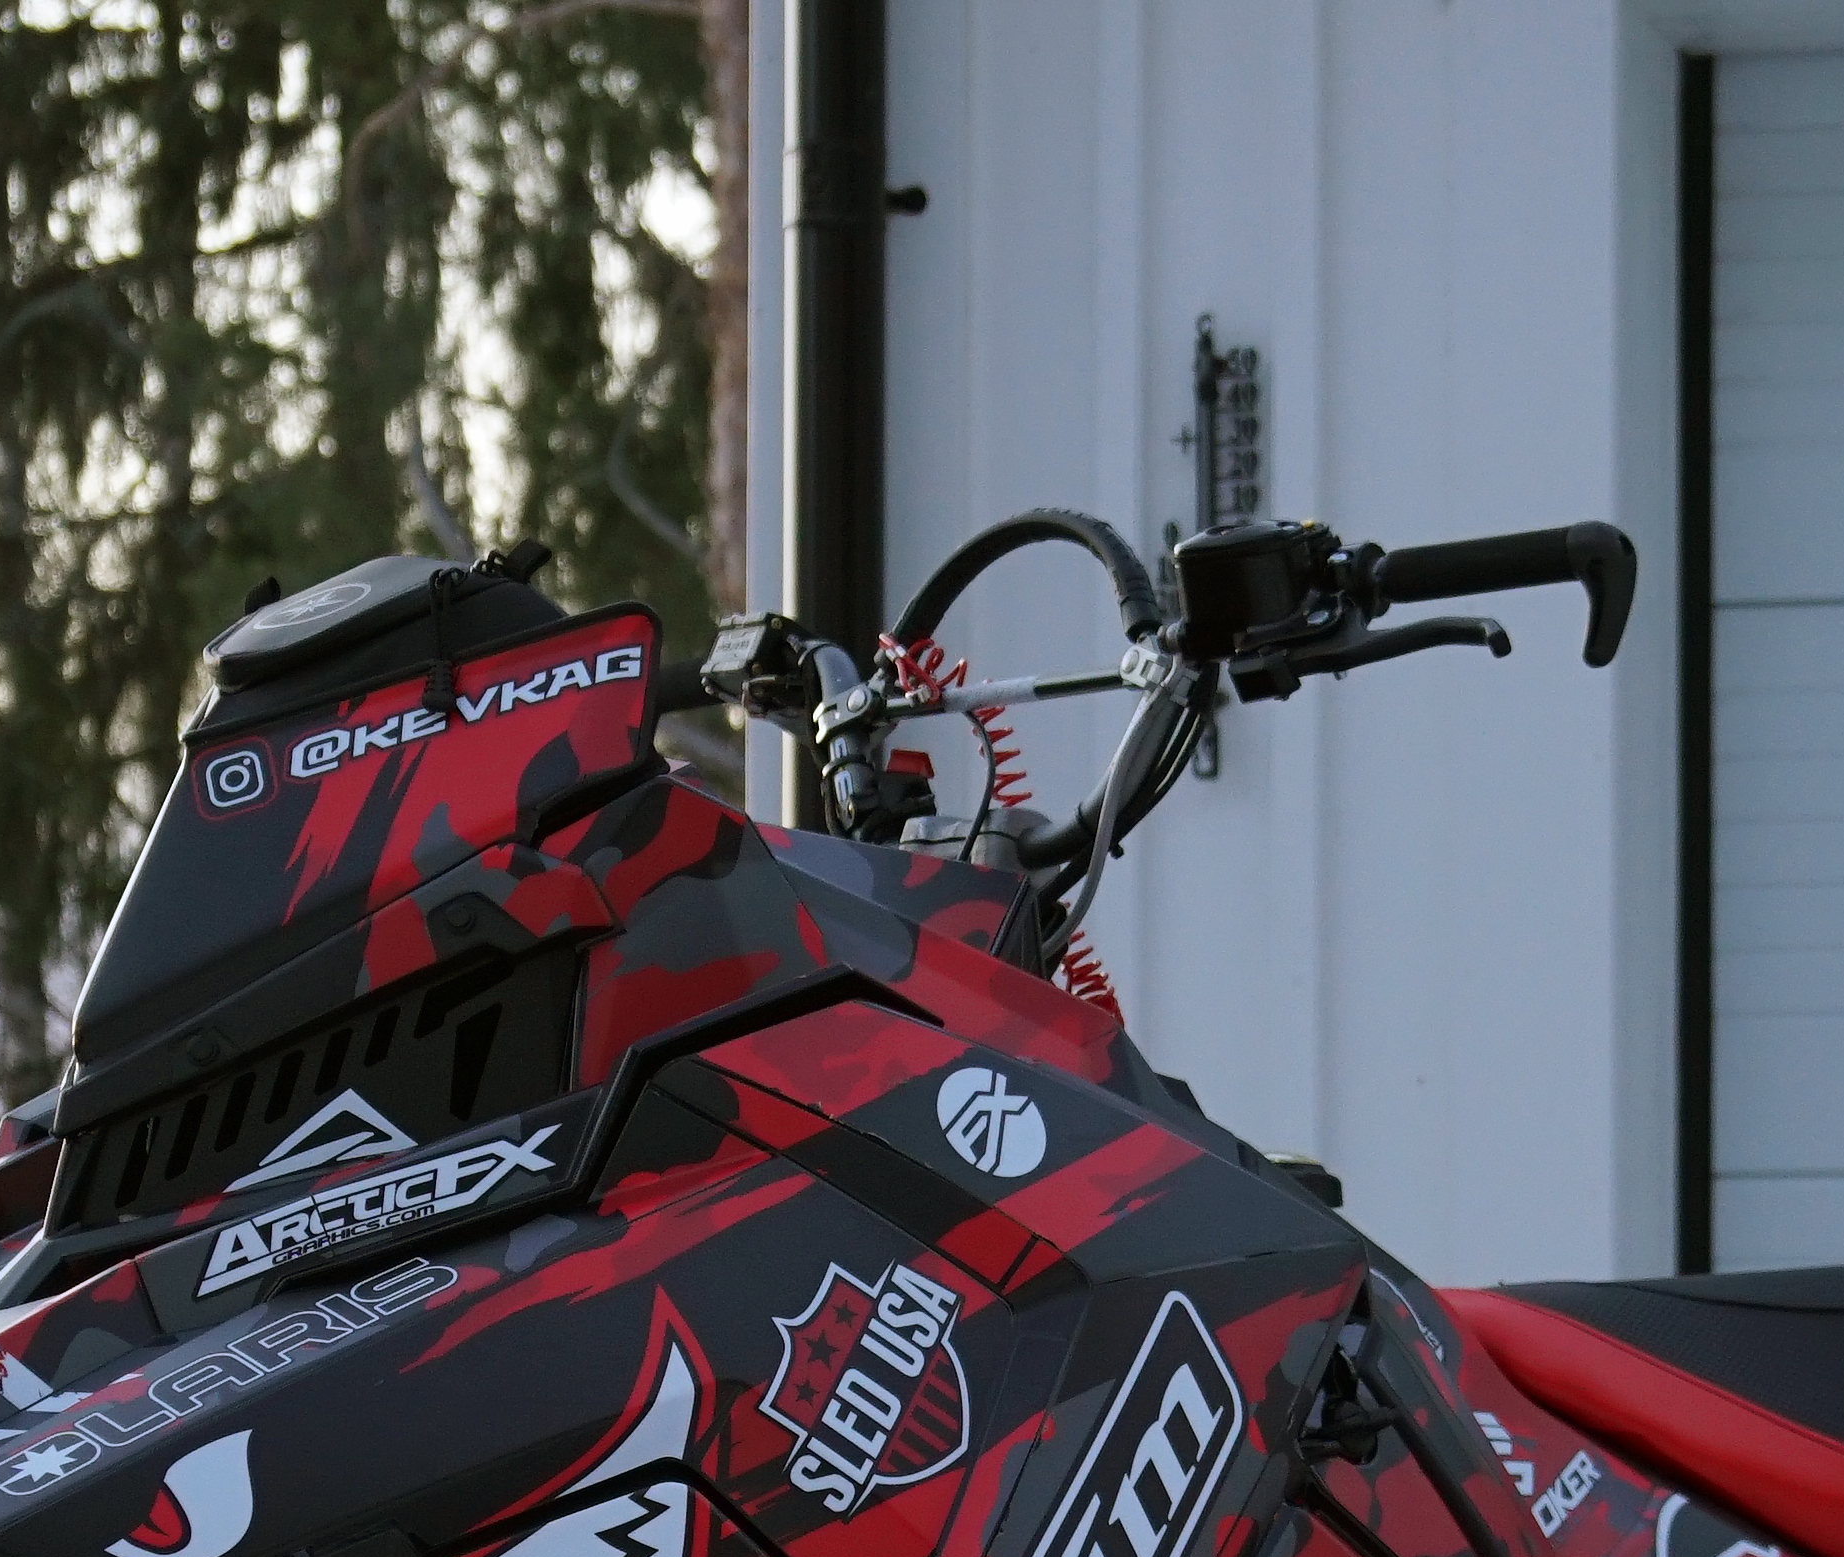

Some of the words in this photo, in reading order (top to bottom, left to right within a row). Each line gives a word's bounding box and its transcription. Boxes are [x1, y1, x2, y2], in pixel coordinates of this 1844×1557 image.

[289, 645, 643, 779] @KEVKAG
[789, 1367, 903, 1514] SLED
[859, 1263, 958, 1379] USA
